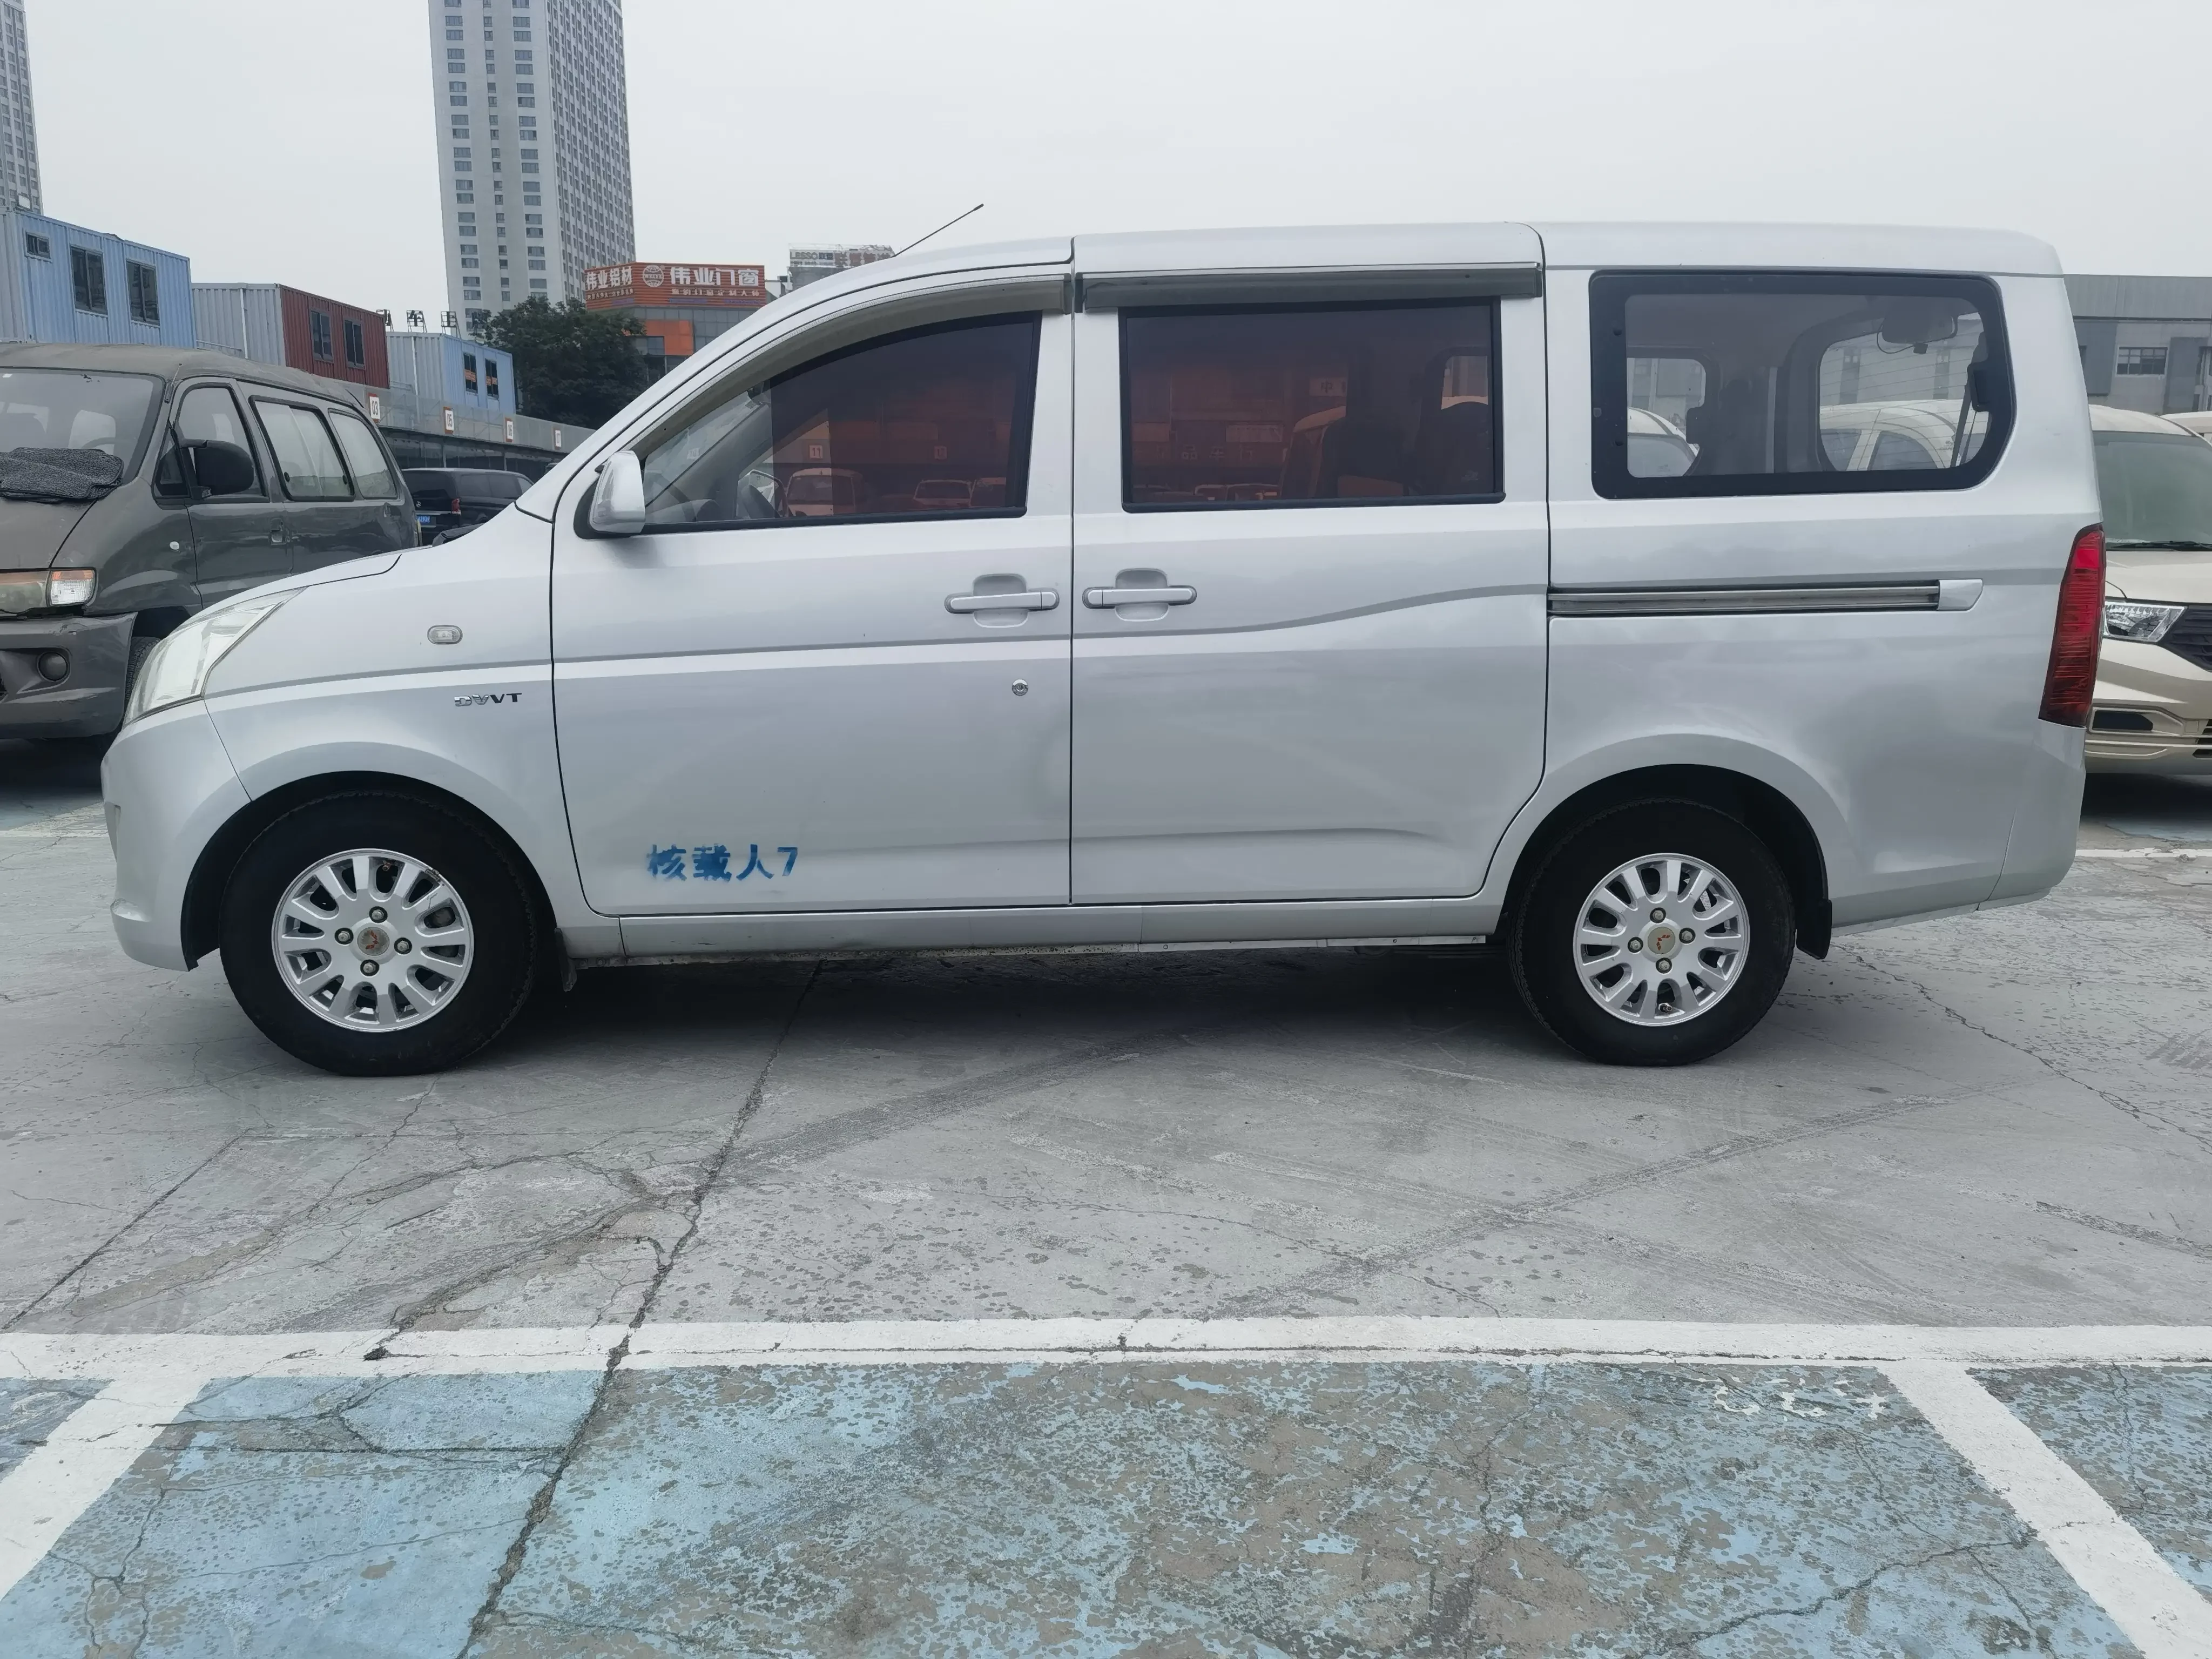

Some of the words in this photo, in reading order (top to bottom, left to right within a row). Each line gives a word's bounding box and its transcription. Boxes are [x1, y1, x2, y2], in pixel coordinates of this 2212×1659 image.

[586, 266, 632, 291] 伟业铝材
[670, 267, 759, 286] 伟业门窗
[372, 400, 378, 415] 03
[454, 692, 522, 707] DVVT
[646, 844, 798, 882] 核载人7
